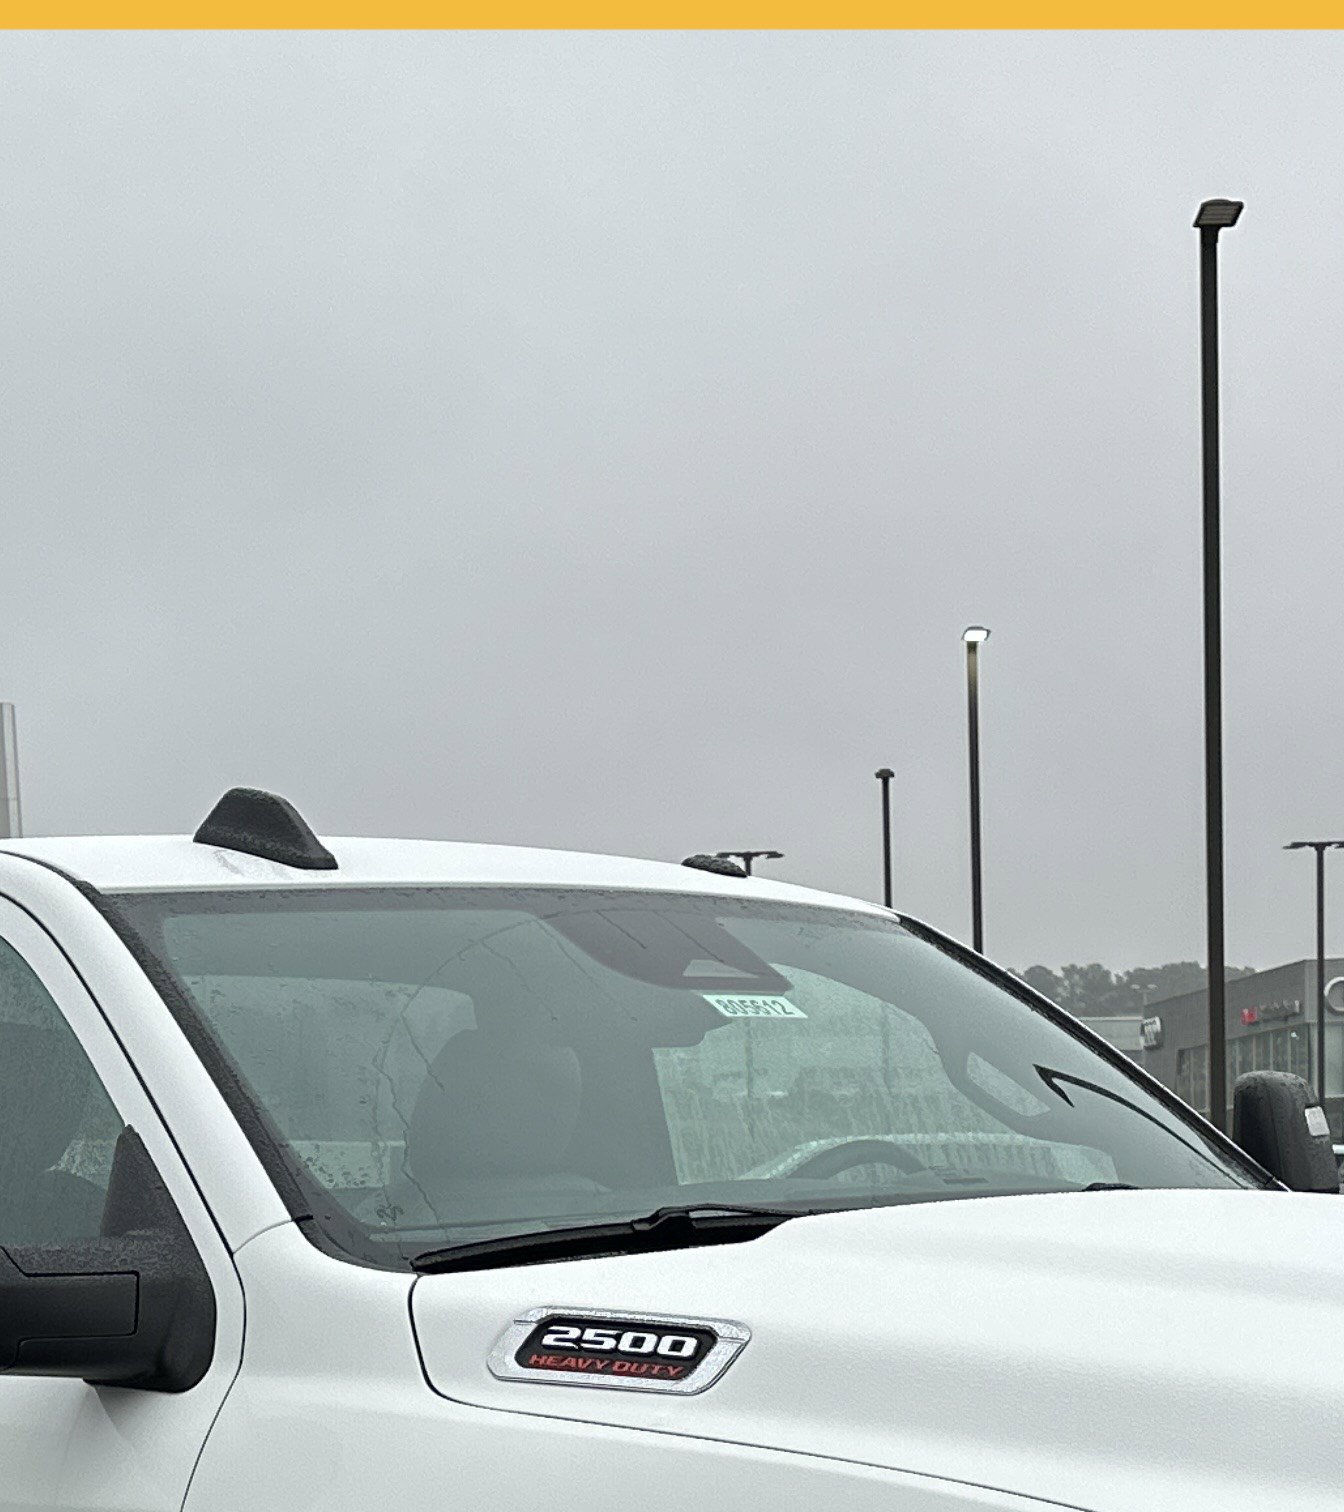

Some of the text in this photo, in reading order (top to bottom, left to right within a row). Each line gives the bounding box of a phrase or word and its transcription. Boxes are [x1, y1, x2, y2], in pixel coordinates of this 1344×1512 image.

[541, 1326, 698, 1358] 2500
[529, 1354, 684, 1377] HEAVY DUTY
